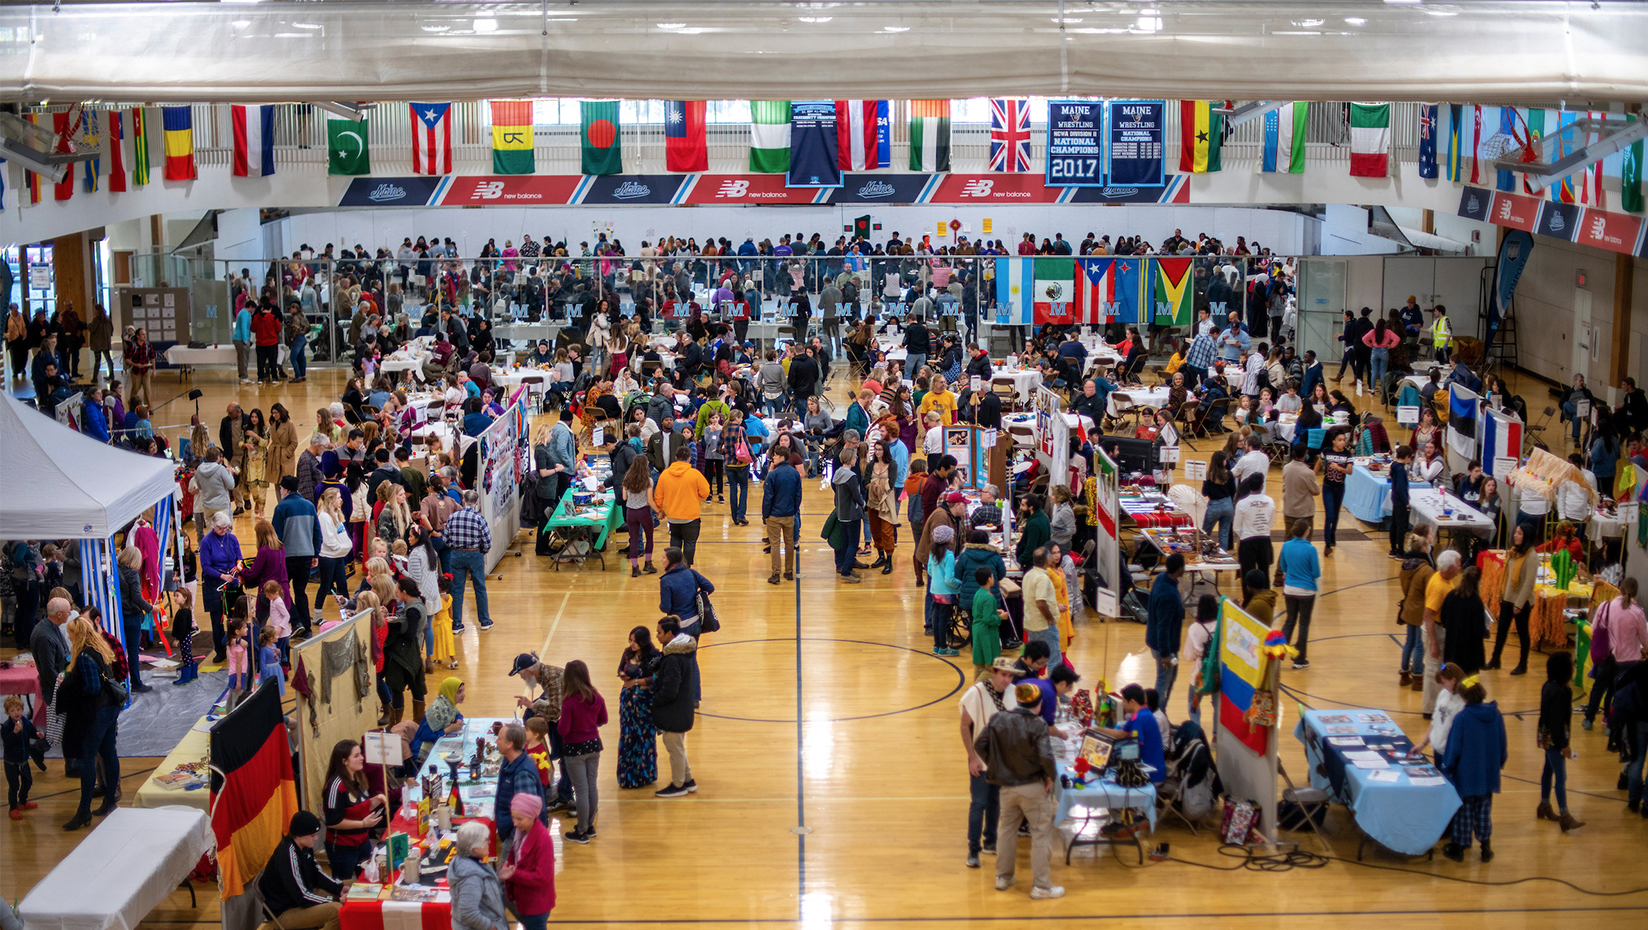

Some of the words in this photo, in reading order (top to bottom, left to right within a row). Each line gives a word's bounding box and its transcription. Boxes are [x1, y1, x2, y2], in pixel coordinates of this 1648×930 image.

[1061, 105, 1091, 115] MAINE
[1122, 105, 1152, 115] MAINE
[1053, 138, 1097, 146] NATIONAL
[1050, 146, 1099, 154] CHAMPIONS
[1051, 158, 1098, 178] 2017
[368, 183, 407, 201] Maine
[611, 181, 650, 199] Maine
[856, 180, 896, 199] Maine
[205, 304, 218, 319] M
[405, 305, 421, 319] M
[512, 303, 529, 318] M
[566, 303, 584, 318] M
[673, 303, 691, 317] M
[727, 302, 745, 317] M
[781, 302, 799, 317] M
[834, 302, 853, 317] M
[889, 302, 907, 316] M
[942, 302, 960, 316] M
[995, 302, 1014, 316] M
[1049, 302, 1067, 316] M
[1102, 302, 1121, 316] M
[1155, 302, 1174, 316] M
[1209, 301, 1227, 316] M
